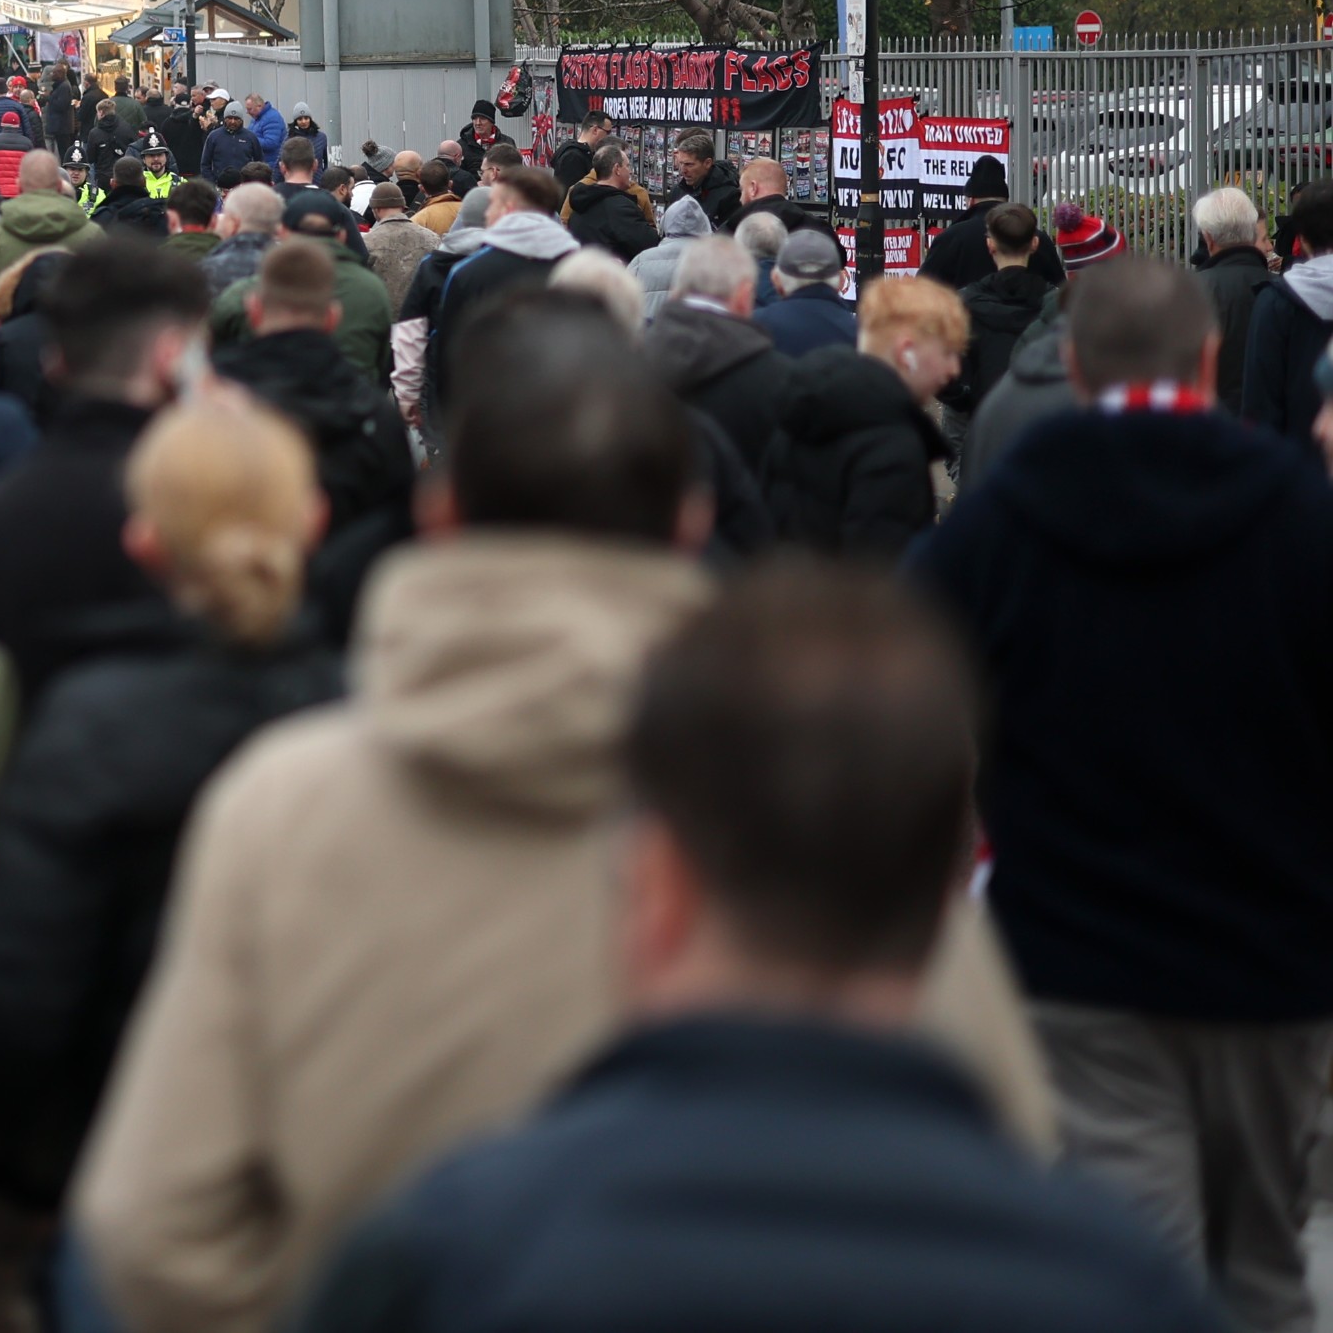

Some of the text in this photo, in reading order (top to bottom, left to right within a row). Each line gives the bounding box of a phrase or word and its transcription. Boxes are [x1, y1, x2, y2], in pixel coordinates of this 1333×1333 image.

[561, 54, 609, 90] CUSTOM
[610, 50, 650, 90] FLAGS
[650, 51, 668, 90] BY
[668, 51, 721, 90] BARMY
[724, 49, 812, 92] FLAGS
[603, 96, 712, 122] ORDER HERE AND PAY ONLINE
[924, 124, 1003, 146] MAN UNITED
[924, 159, 974, 177] THE REL
[923, 192, 953, 209] WE'LL
